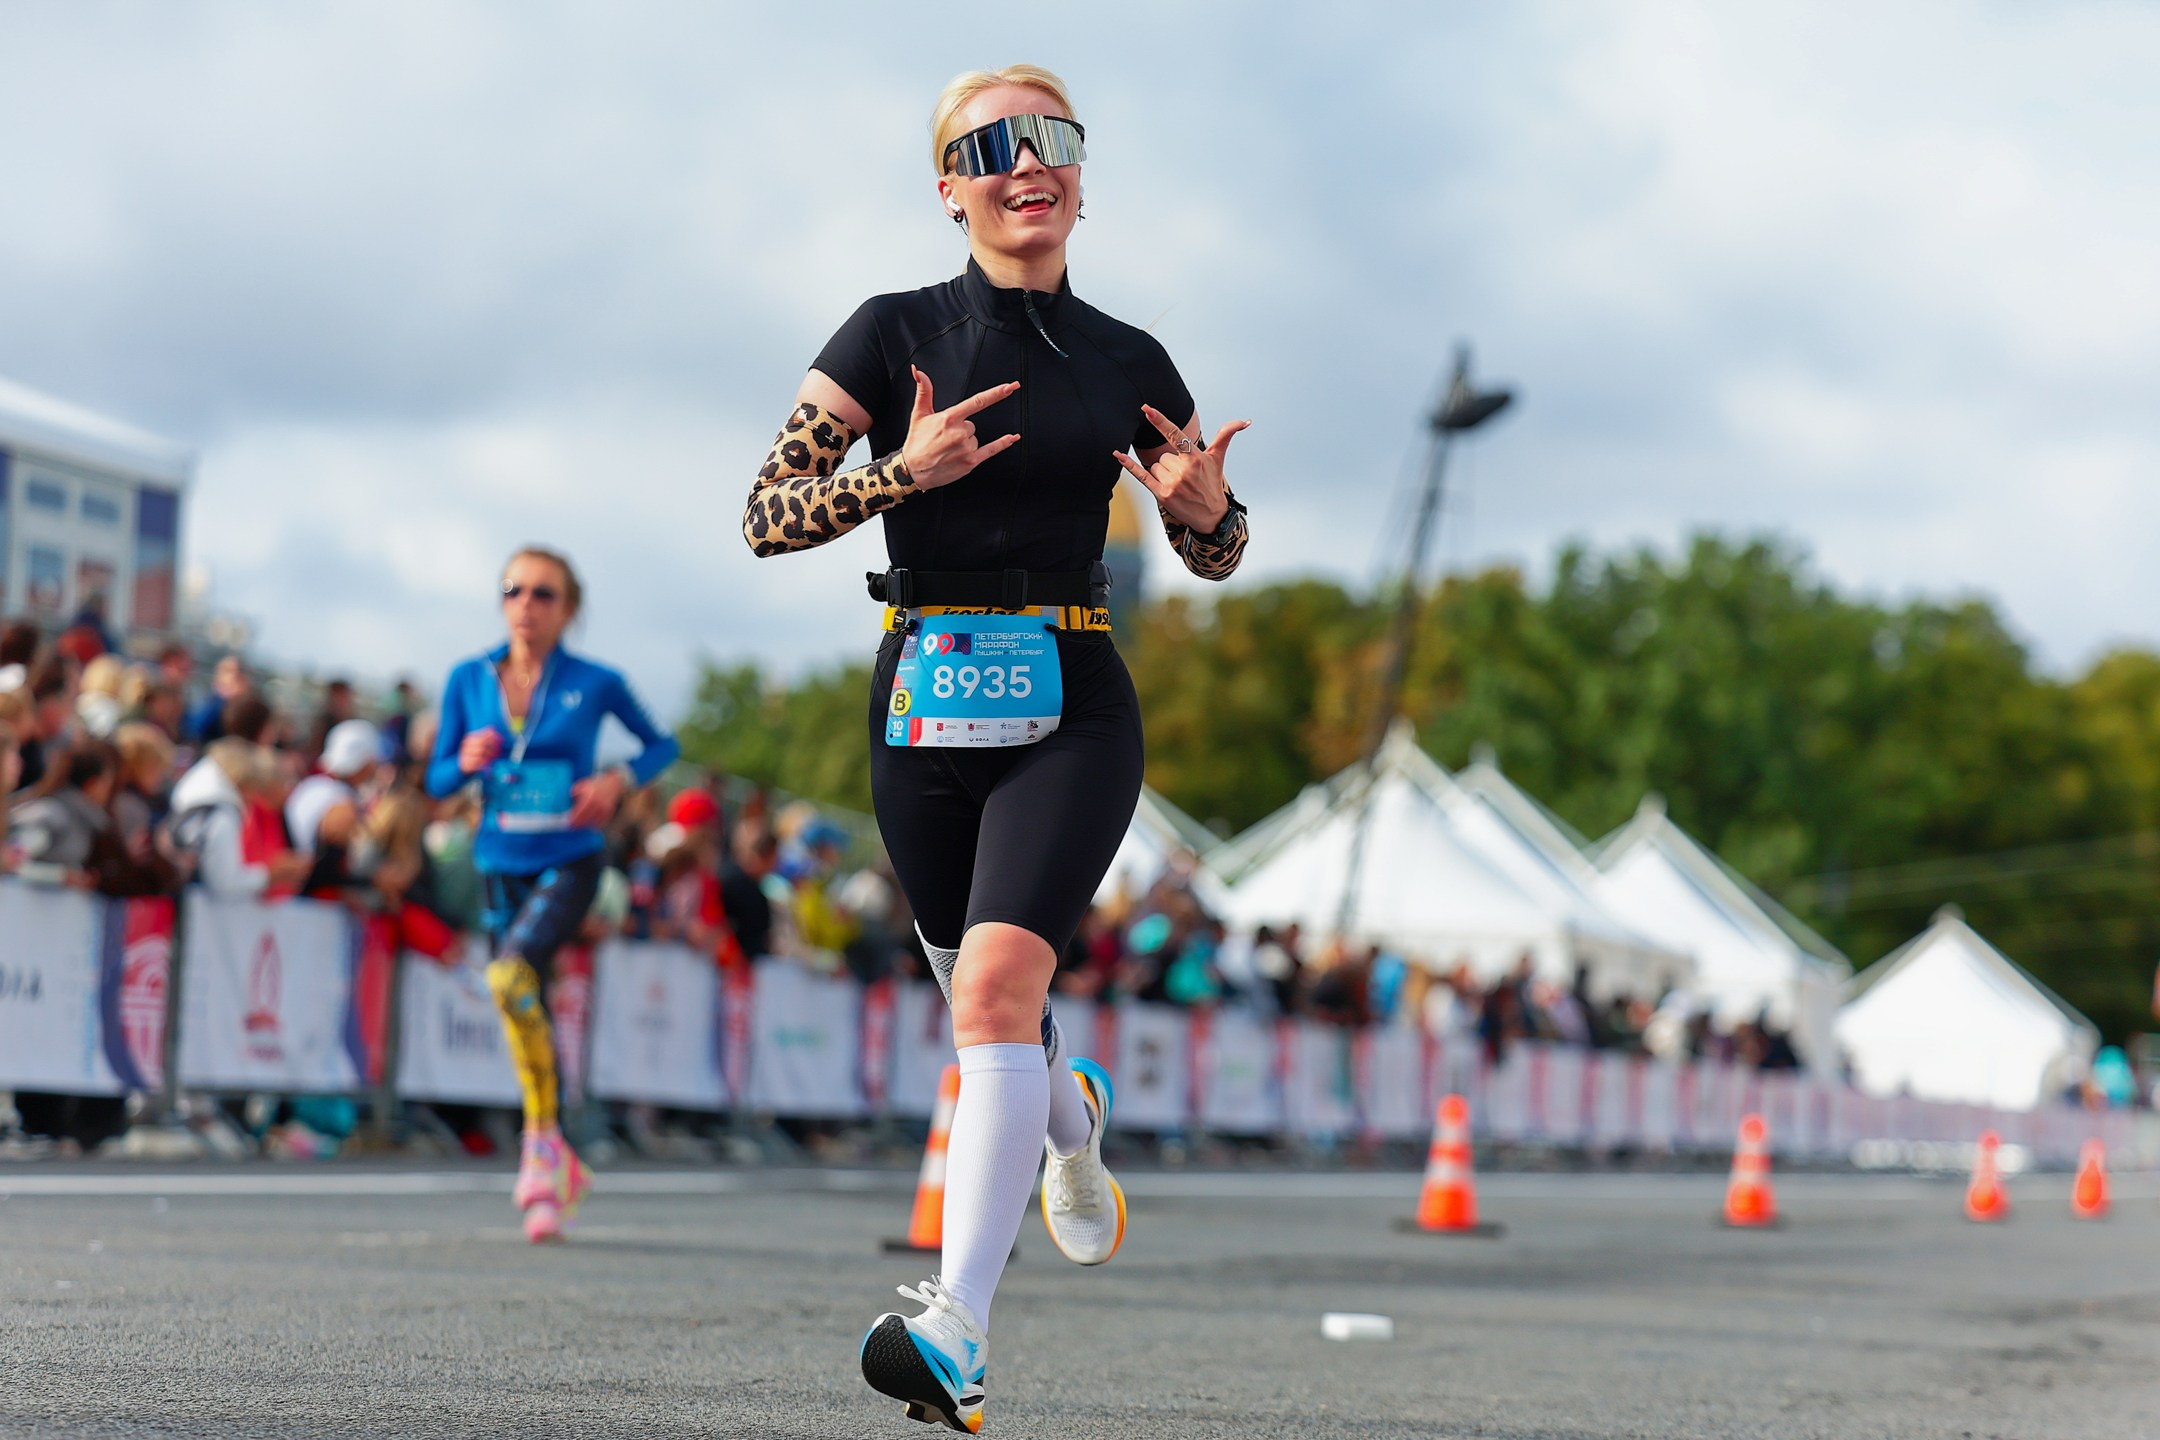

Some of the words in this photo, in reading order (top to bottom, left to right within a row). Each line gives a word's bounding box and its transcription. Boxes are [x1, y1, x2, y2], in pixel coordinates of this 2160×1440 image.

[974, 632, 1043, 640] ПЕТЕРБУРГСКИЙ
[974, 641, 1020, 649] МАРАФОН
[933, 665, 1032, 699] 8935
[894, 693, 906, 711] B
[893, 720, 904, 731] 10
